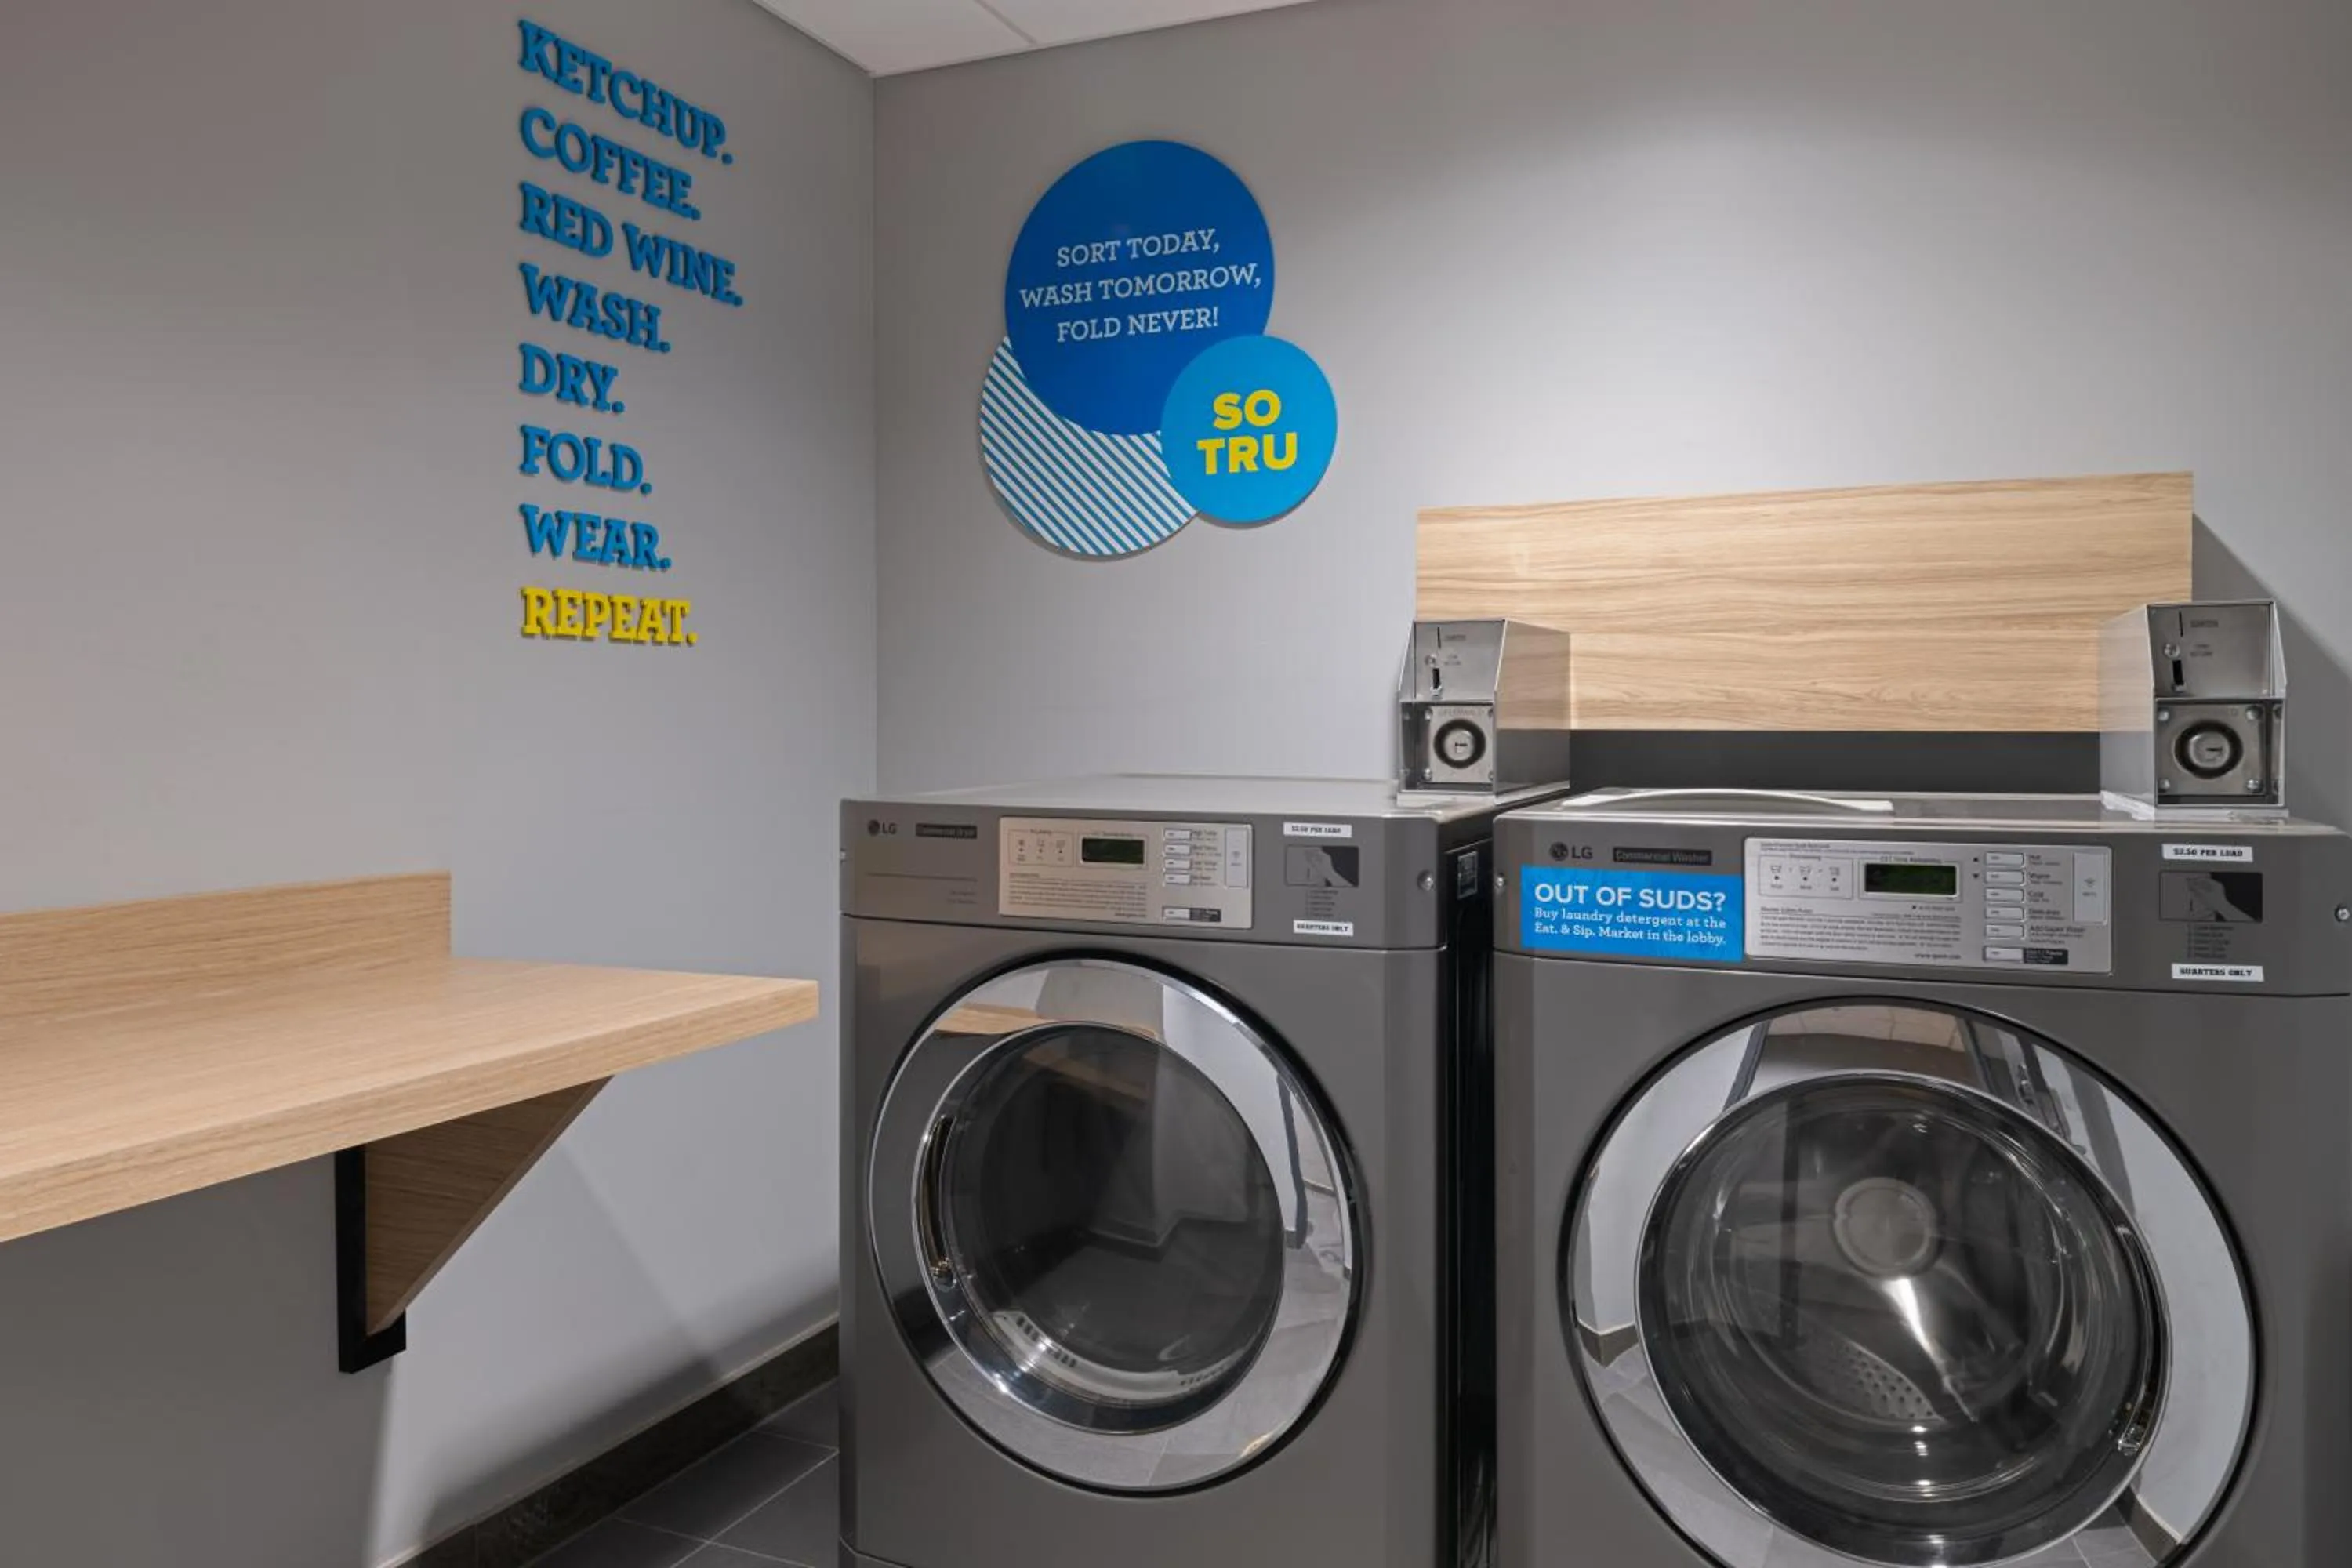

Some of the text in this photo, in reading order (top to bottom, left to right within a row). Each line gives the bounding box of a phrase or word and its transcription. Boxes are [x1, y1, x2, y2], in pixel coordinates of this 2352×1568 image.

[518, 19, 733, 165] KETCHUP.
[520, 107, 702, 220] COFFEE.
[519, 181, 744, 307] RED WINE.
[1057, 228, 1220, 267] SORT TODAY,
[518, 262, 672, 353] WASH.
[1020, 263, 1261, 308] WASH TOMORROW,
[1057, 307, 1219, 343] FOLD NEVER!
[518, 342, 626, 413] DRY.
[1213, 389, 1282, 430] SO
[518, 424, 652, 495] FOLD.
[1196, 432, 1298, 475] TRU
[518, 503, 672, 569] WEAR.
[519, 586, 699, 645] REPEAT.
[882, 822, 897, 835] LG
[1571, 845, 1593, 860] LG
[1534, 883, 1726, 912] OUT OF SUDS?
[1534, 907, 1726, 929] Buy laundry detergent at the
[1534, 922, 1726, 947] Eat. & Sip. Market in the lobby.
